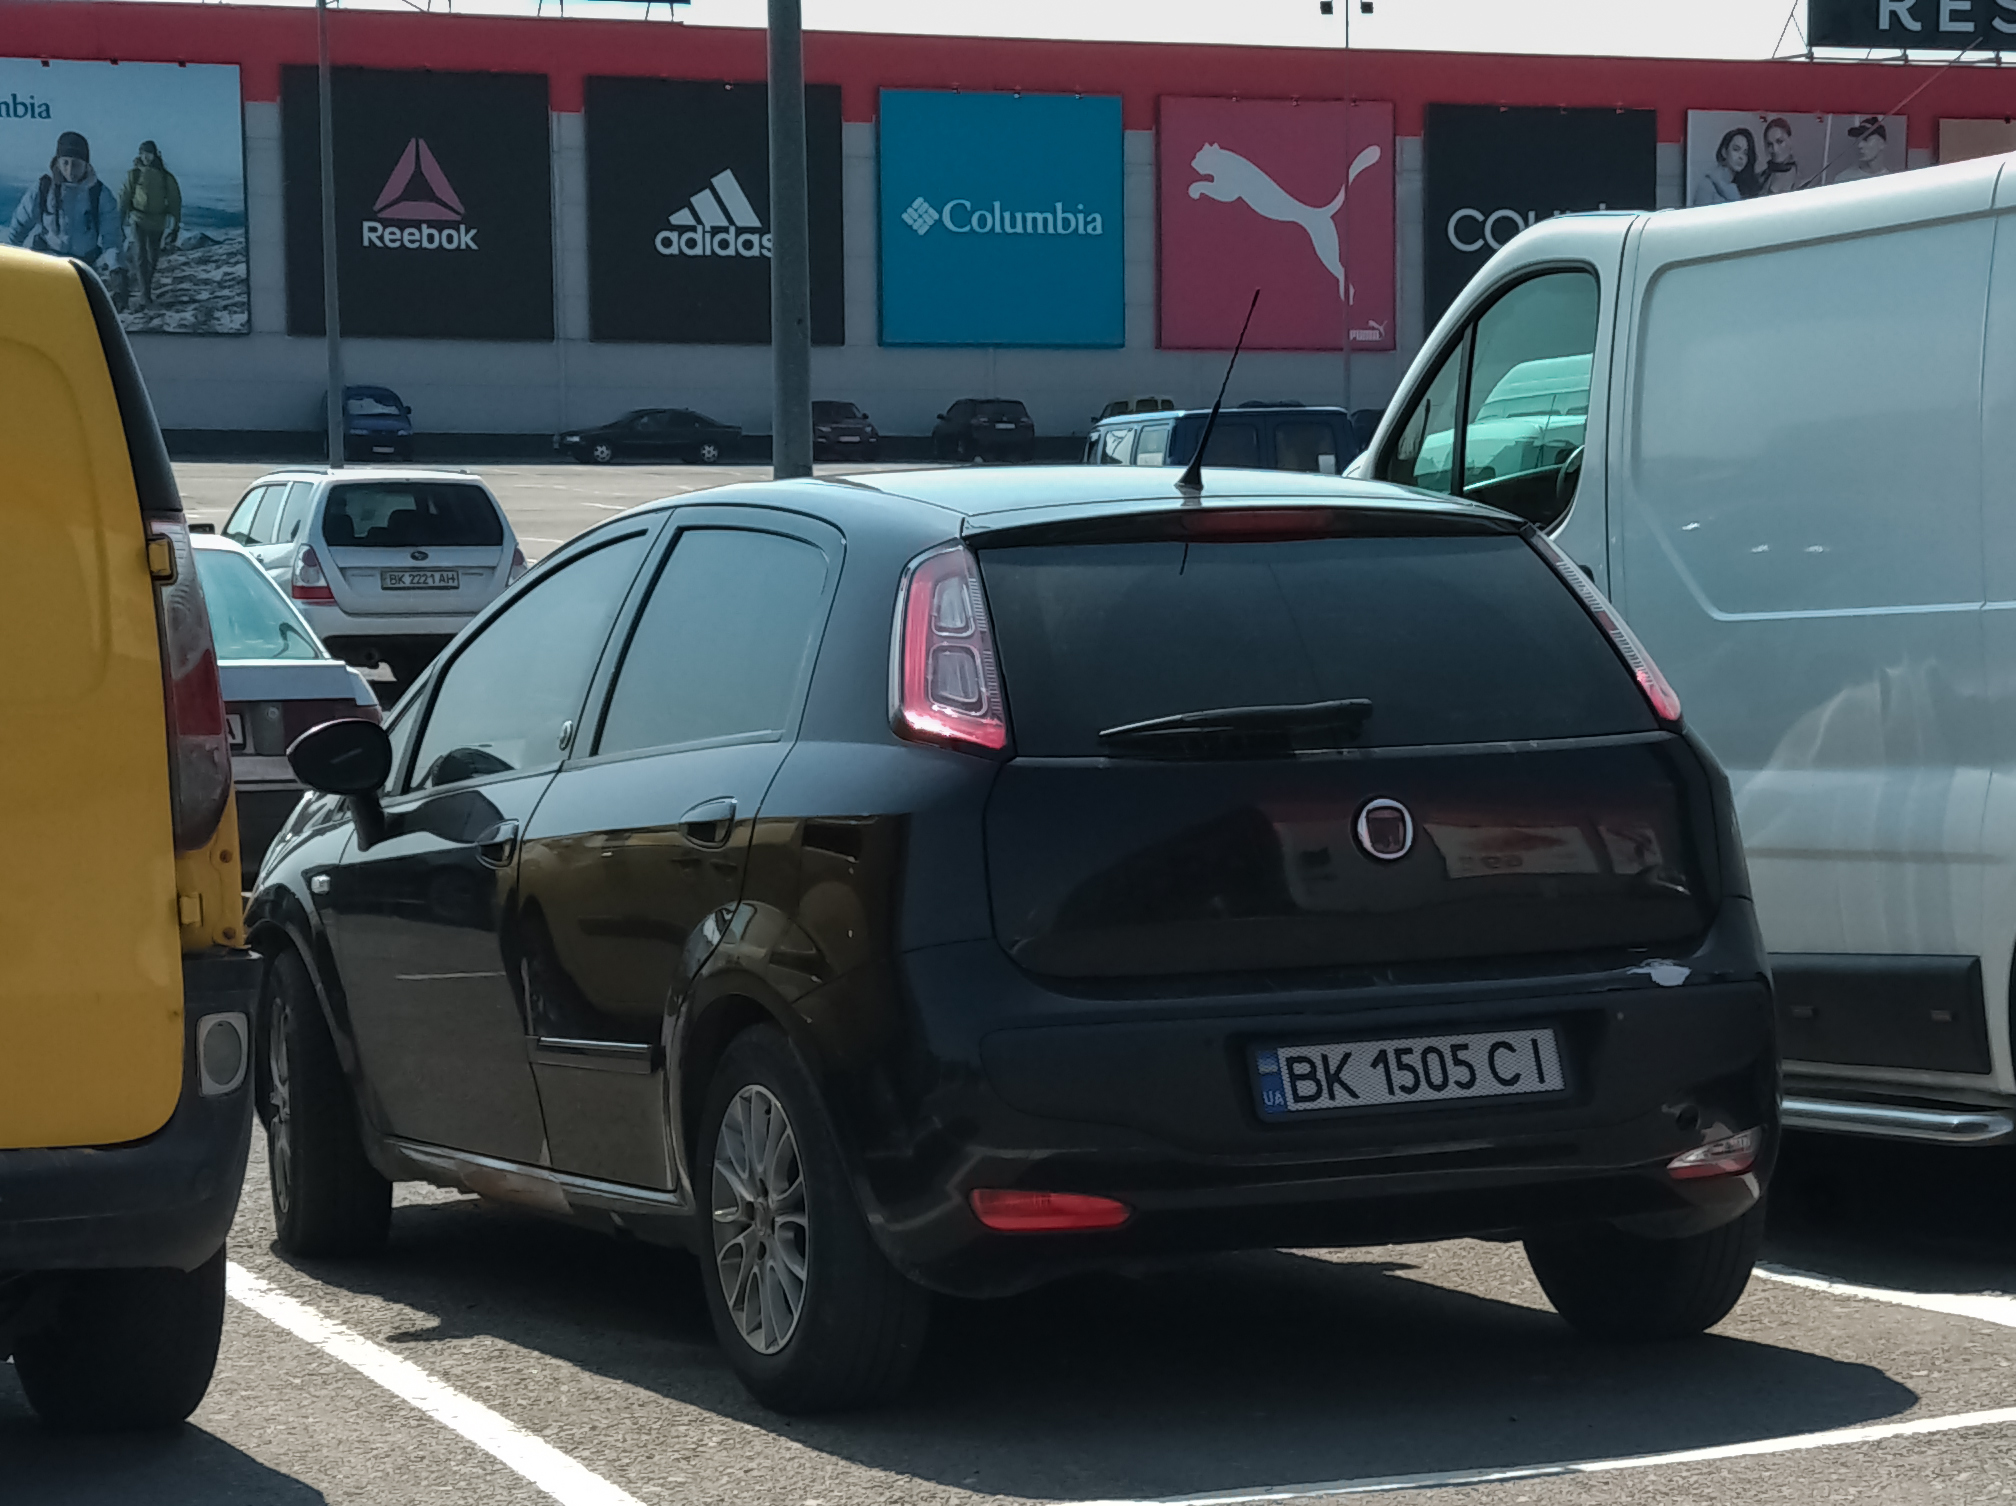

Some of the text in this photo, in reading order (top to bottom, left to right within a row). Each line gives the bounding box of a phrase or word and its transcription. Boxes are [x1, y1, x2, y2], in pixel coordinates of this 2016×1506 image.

[942, 199, 1103, 235] Columbia
[362, 220, 479, 250] Reebok
[389, 573, 456, 585] BK 2221 AH
[1286, 1038, 1546, 1103] BK 1505 CI
[1263, 1091, 1285, 1106] UA
